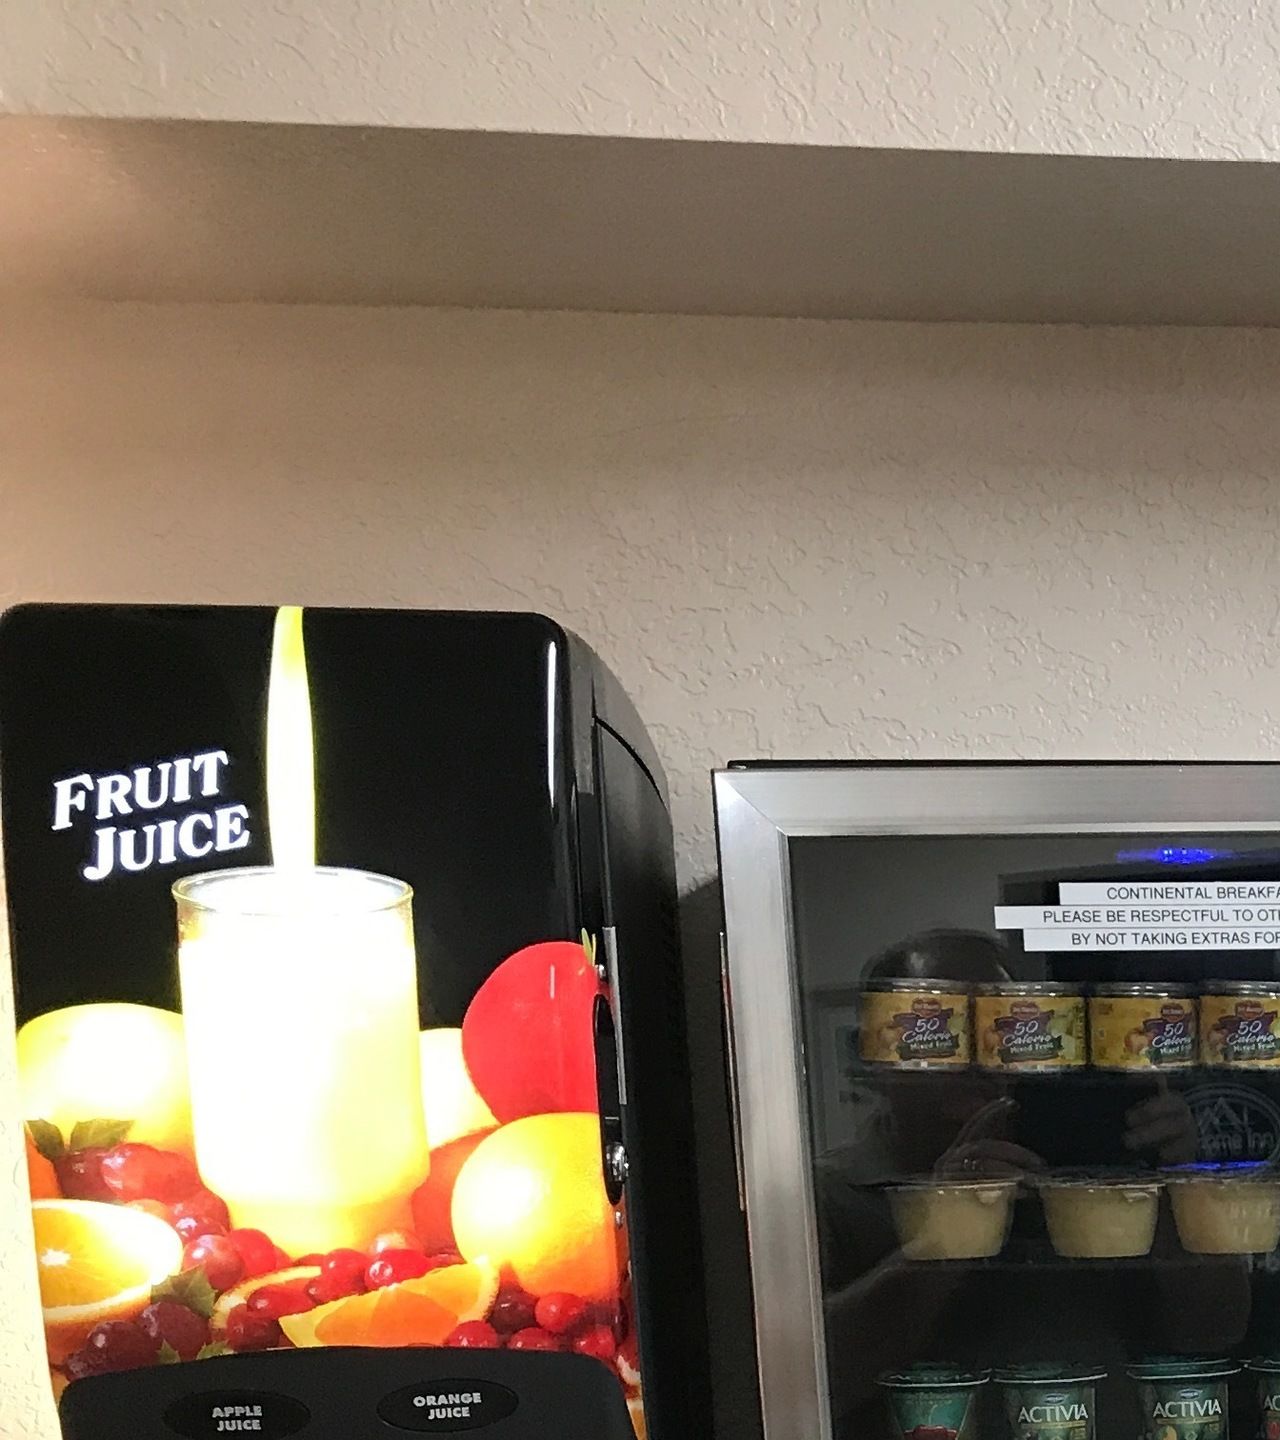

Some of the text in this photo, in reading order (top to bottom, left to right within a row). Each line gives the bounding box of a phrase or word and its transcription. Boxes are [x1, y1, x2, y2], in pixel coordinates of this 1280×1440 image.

[51, 749, 229, 831] FRUIT
[82, 803, 251, 881] JUICE
[1107, 886, 1213, 900] CONTINENTAL
[1042, 909, 1102, 923] PLEASE
[1106, 909, 1127, 923] BE
[1130, 908, 1229, 922] RESPECTFUL
[1232, 908, 1255, 921] TO
[1071, 932, 1092, 946] BY
[1095, 932, 1128, 945] NOT
[1131, 931, 1188, 945] TAKING
[1191, 931, 1251, 945] EXTRAS
[915, 1018, 939, 1033] 50
[1014, 1020, 1039, 1035] 50
[1163, 1022, 1184, 1037] 50
[1237, 1020, 1263, 1034] 50
[902, 1031, 952, 1043] Calorie
[1003, 1034, 1052, 1047] Calorie
[1226, 1033, 1277, 1044] Calorie
[413, 1392, 482, 1408] ORANGE
[212, 1405, 263, 1418] APPLE
[428, 1406, 470, 1420] JUICE
[1018, 1403, 1089, 1423] ACTIVIA
[1152, 1399, 1222, 1418] ACTIVIA
[216, 1419, 262, 1432] JUICE
